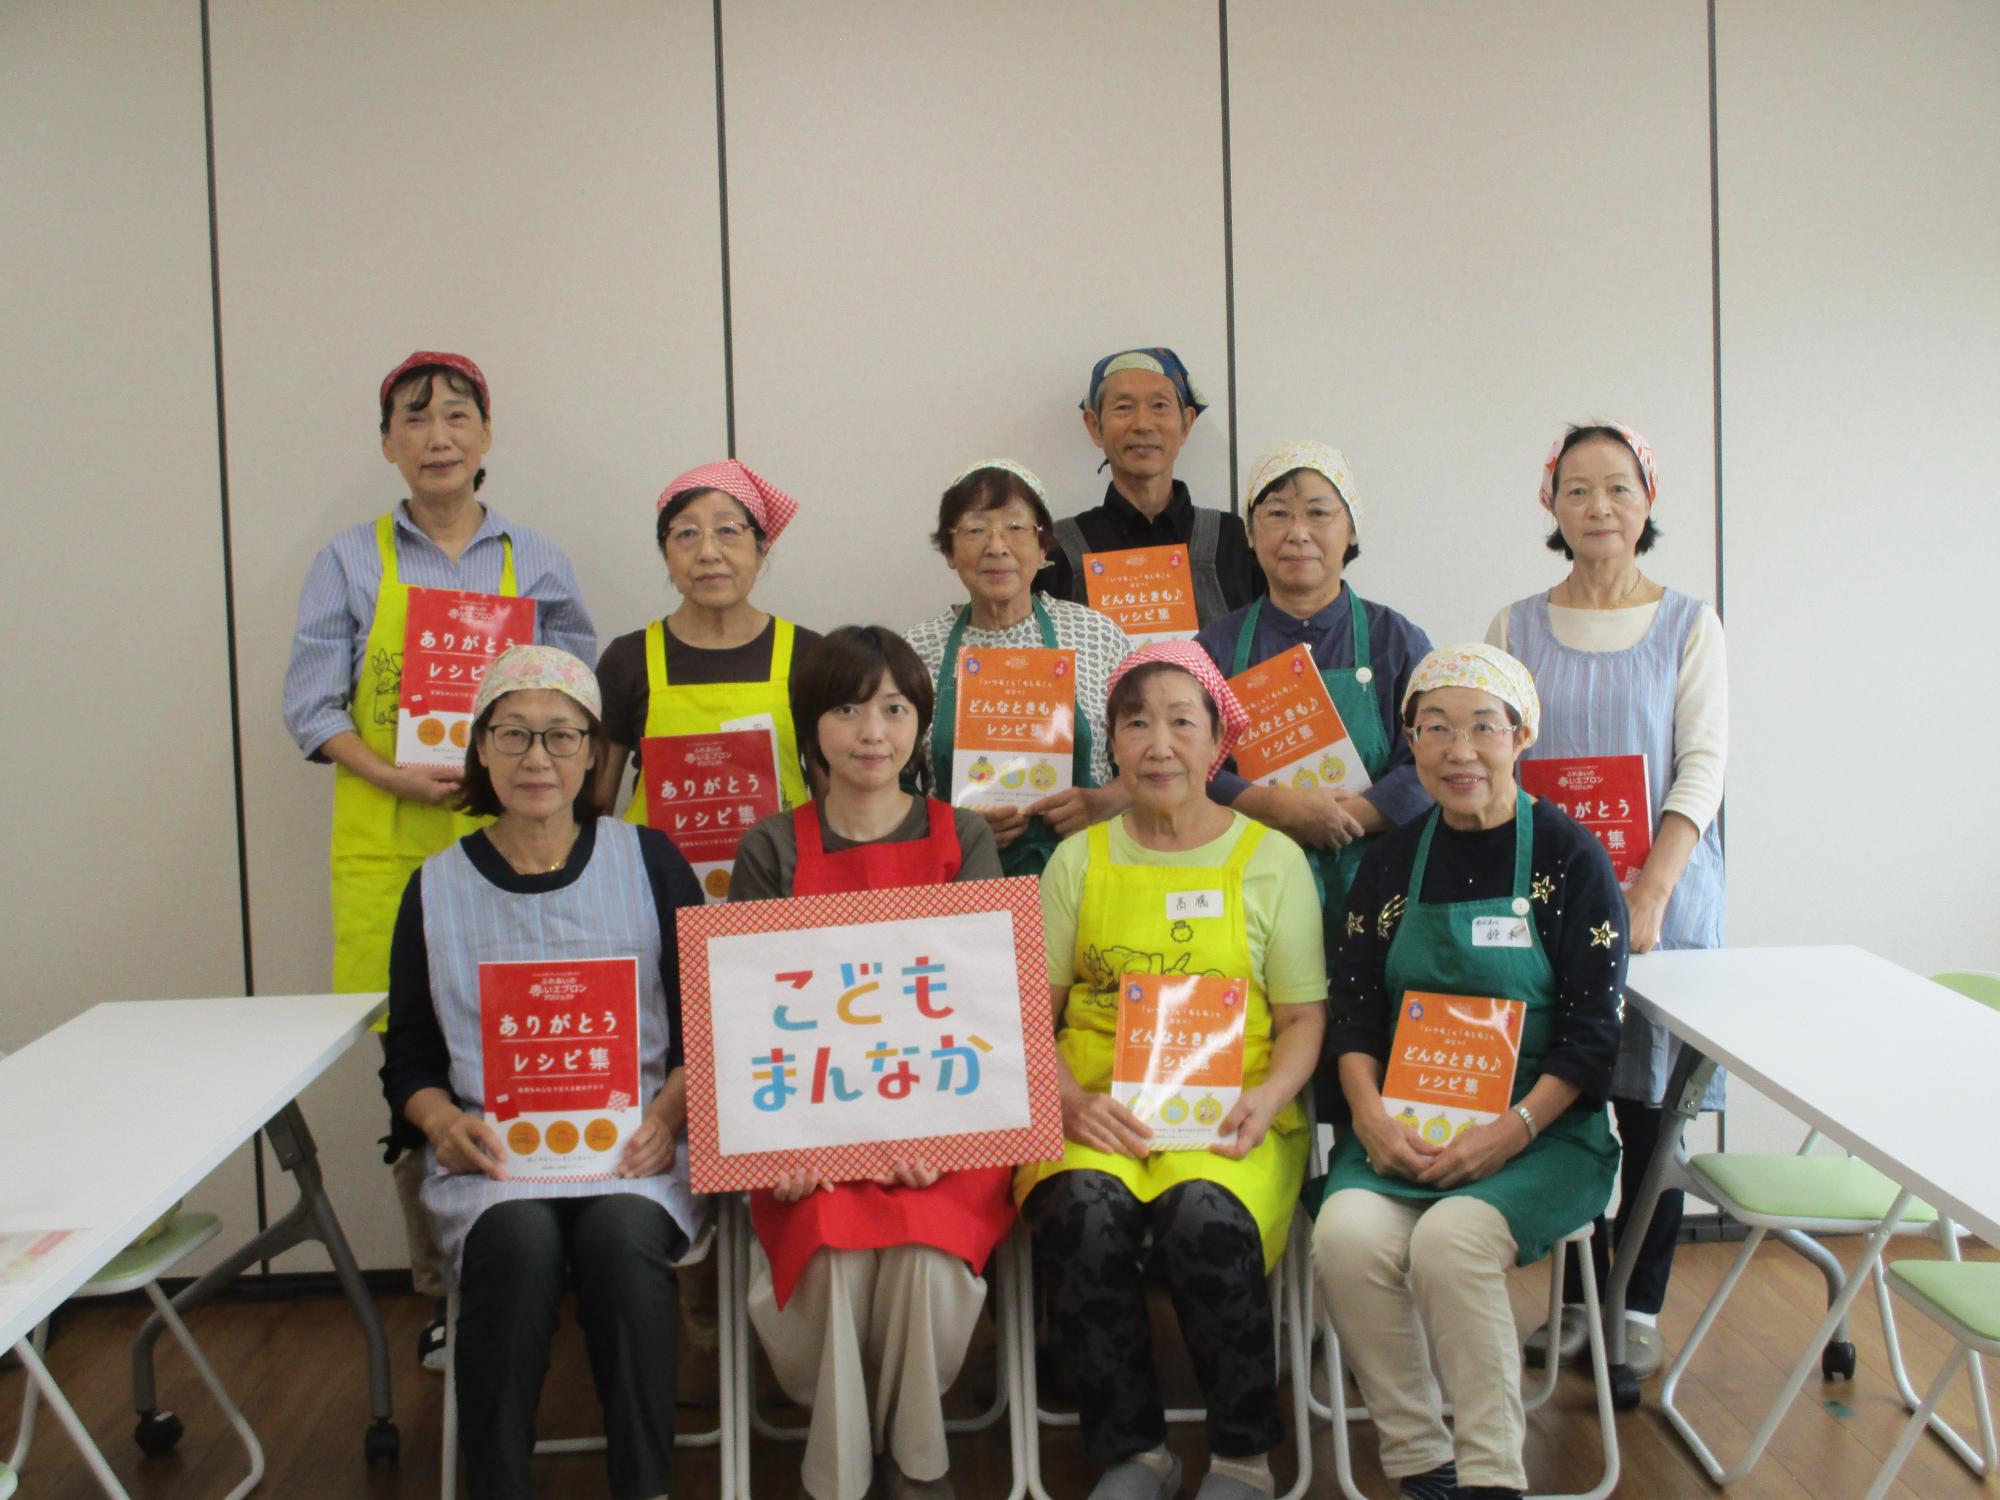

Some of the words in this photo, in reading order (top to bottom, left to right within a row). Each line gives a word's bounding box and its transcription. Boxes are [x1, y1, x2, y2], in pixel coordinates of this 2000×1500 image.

[661, 773, 762, 800] ありがとう
[674, 805, 757, 830] レシピ集
[772, 956, 955, 1031] こども
[499, 1011, 618, 1037] ありがとう
[514, 1047, 611, 1072] レシピ集
[751, 1034, 994, 1112] まんなか
[1418, 1073, 1479, 1094] レシピ集
